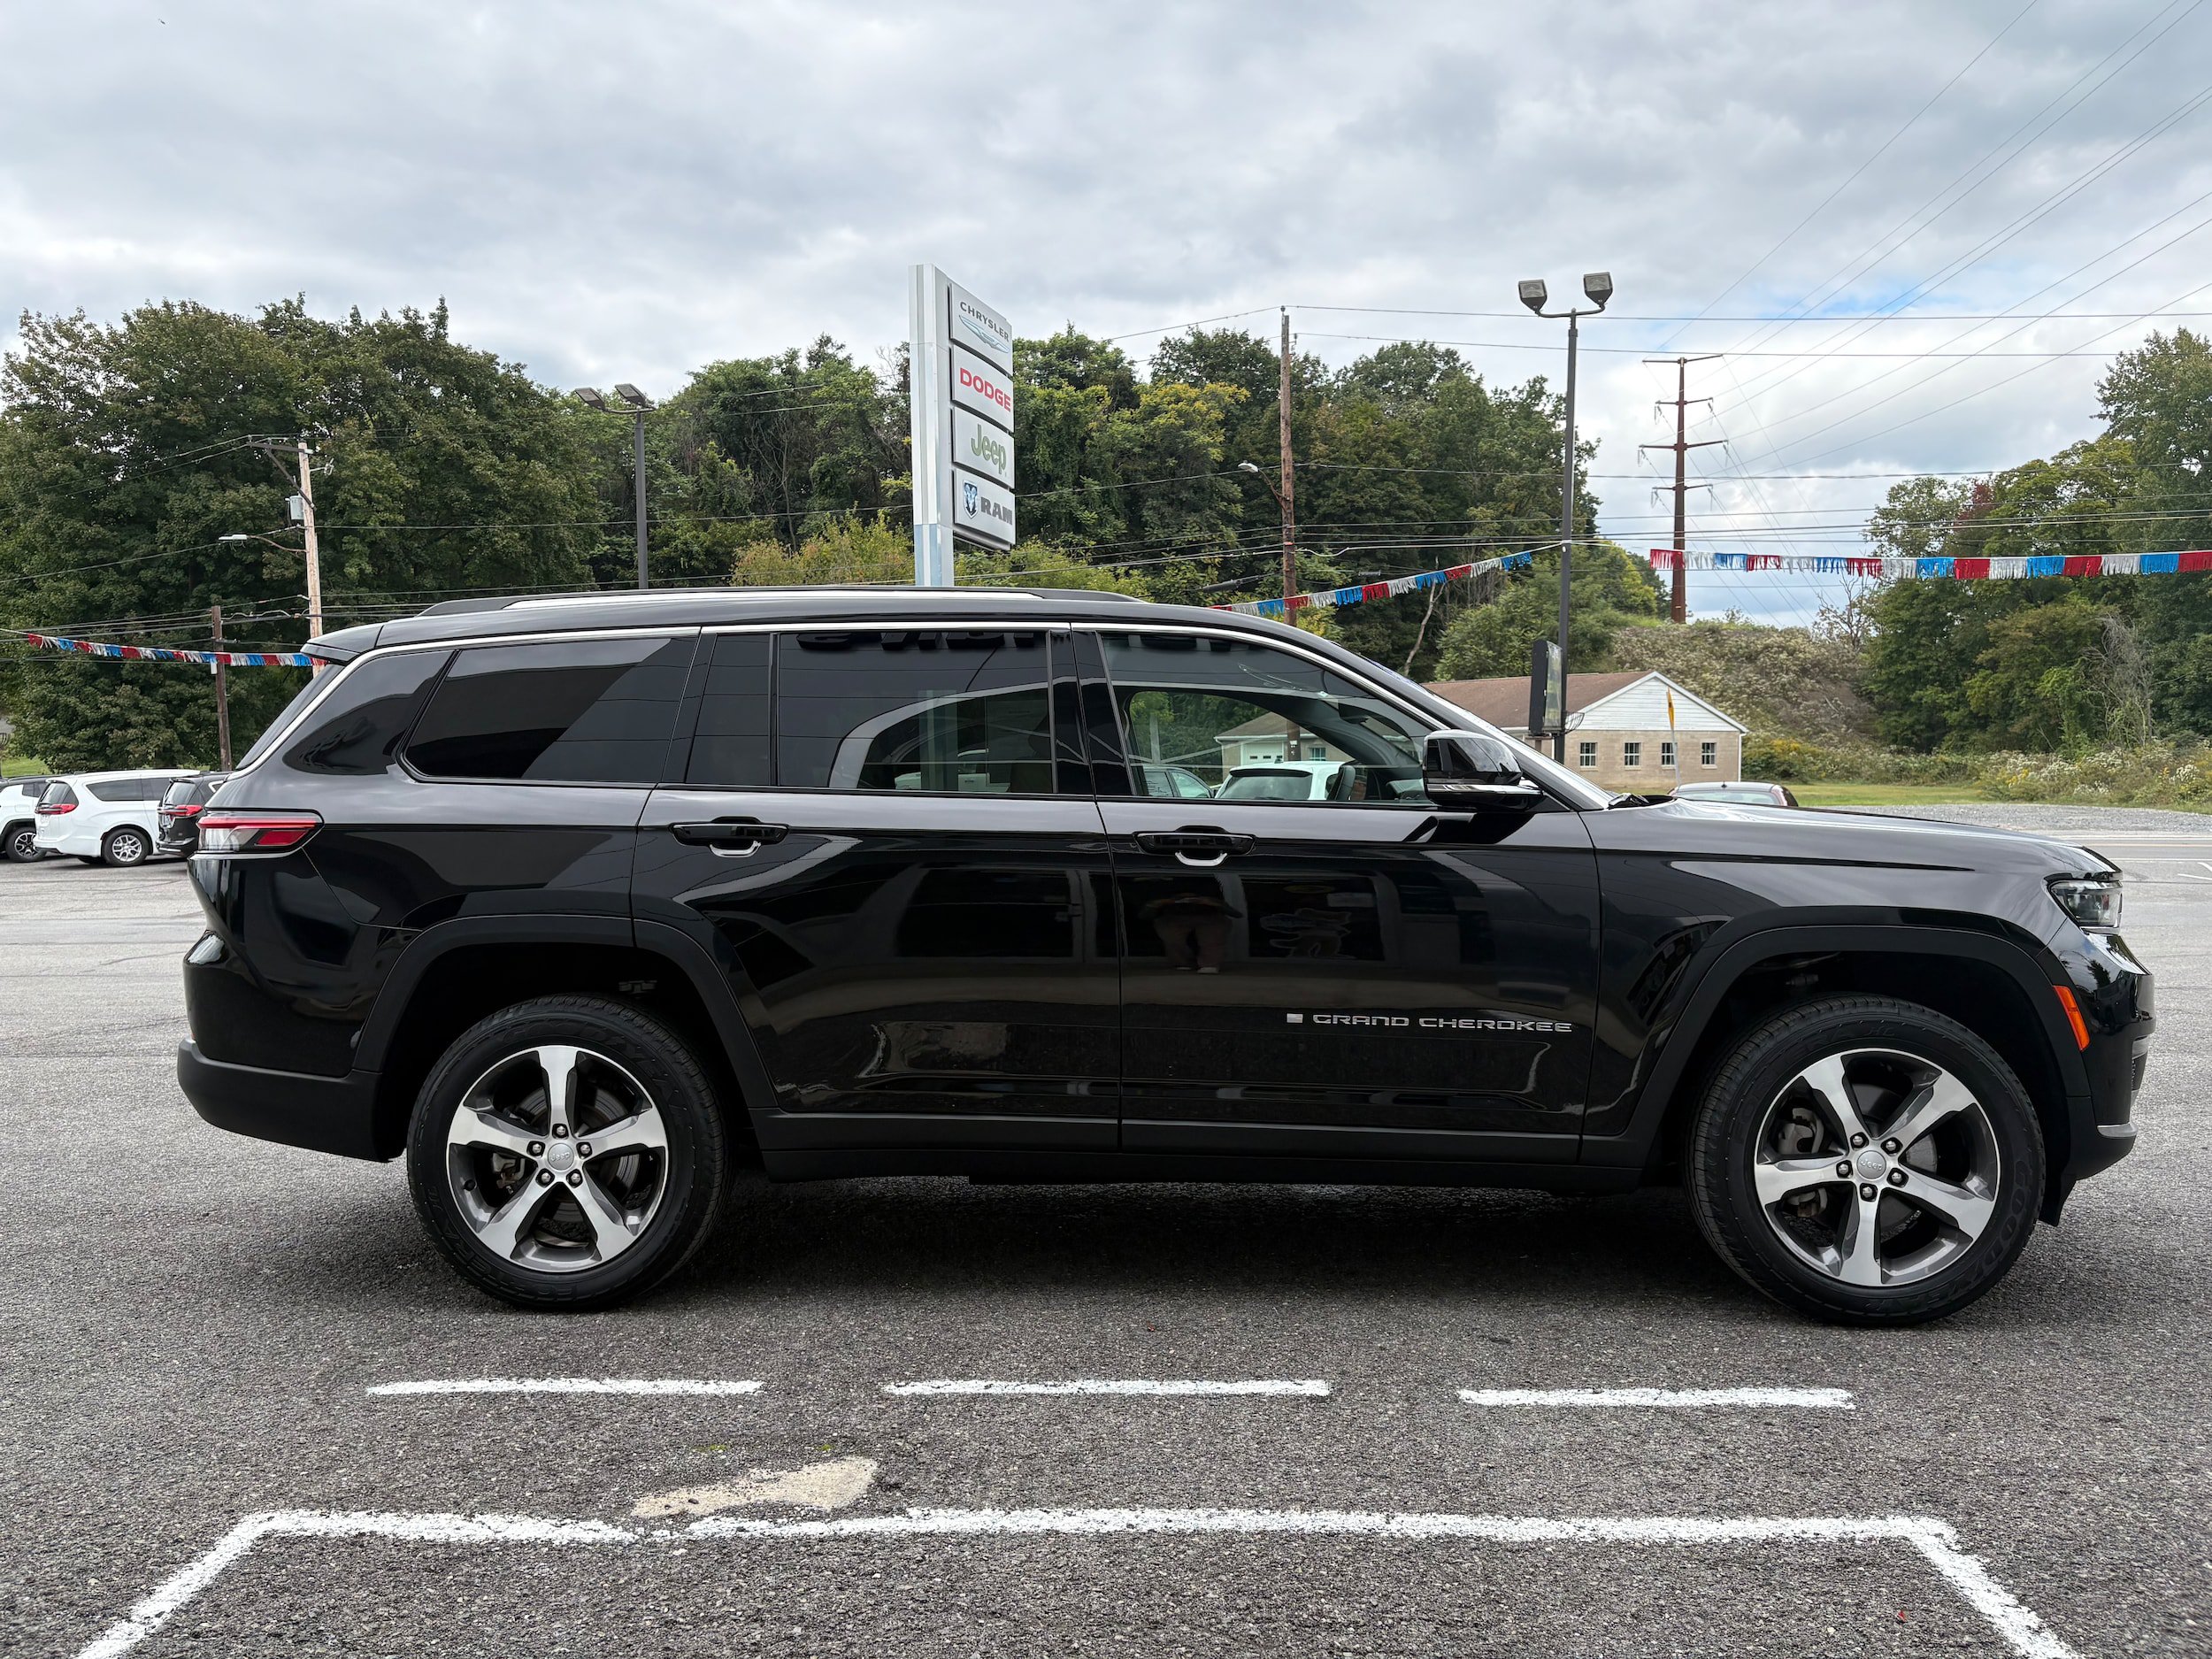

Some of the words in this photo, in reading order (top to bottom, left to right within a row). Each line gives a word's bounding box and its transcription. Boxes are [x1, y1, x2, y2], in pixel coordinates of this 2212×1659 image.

[960, 301, 1010, 342] CHRYSLER
[960, 367, 1011, 412] DODGE
[971, 424, 1007, 474] Jeep
[980, 496, 1013, 525] RAM
[1313, 1014, 1409, 1027] GRAND
[1419, 1018, 1572, 1033] CHEROKEE
